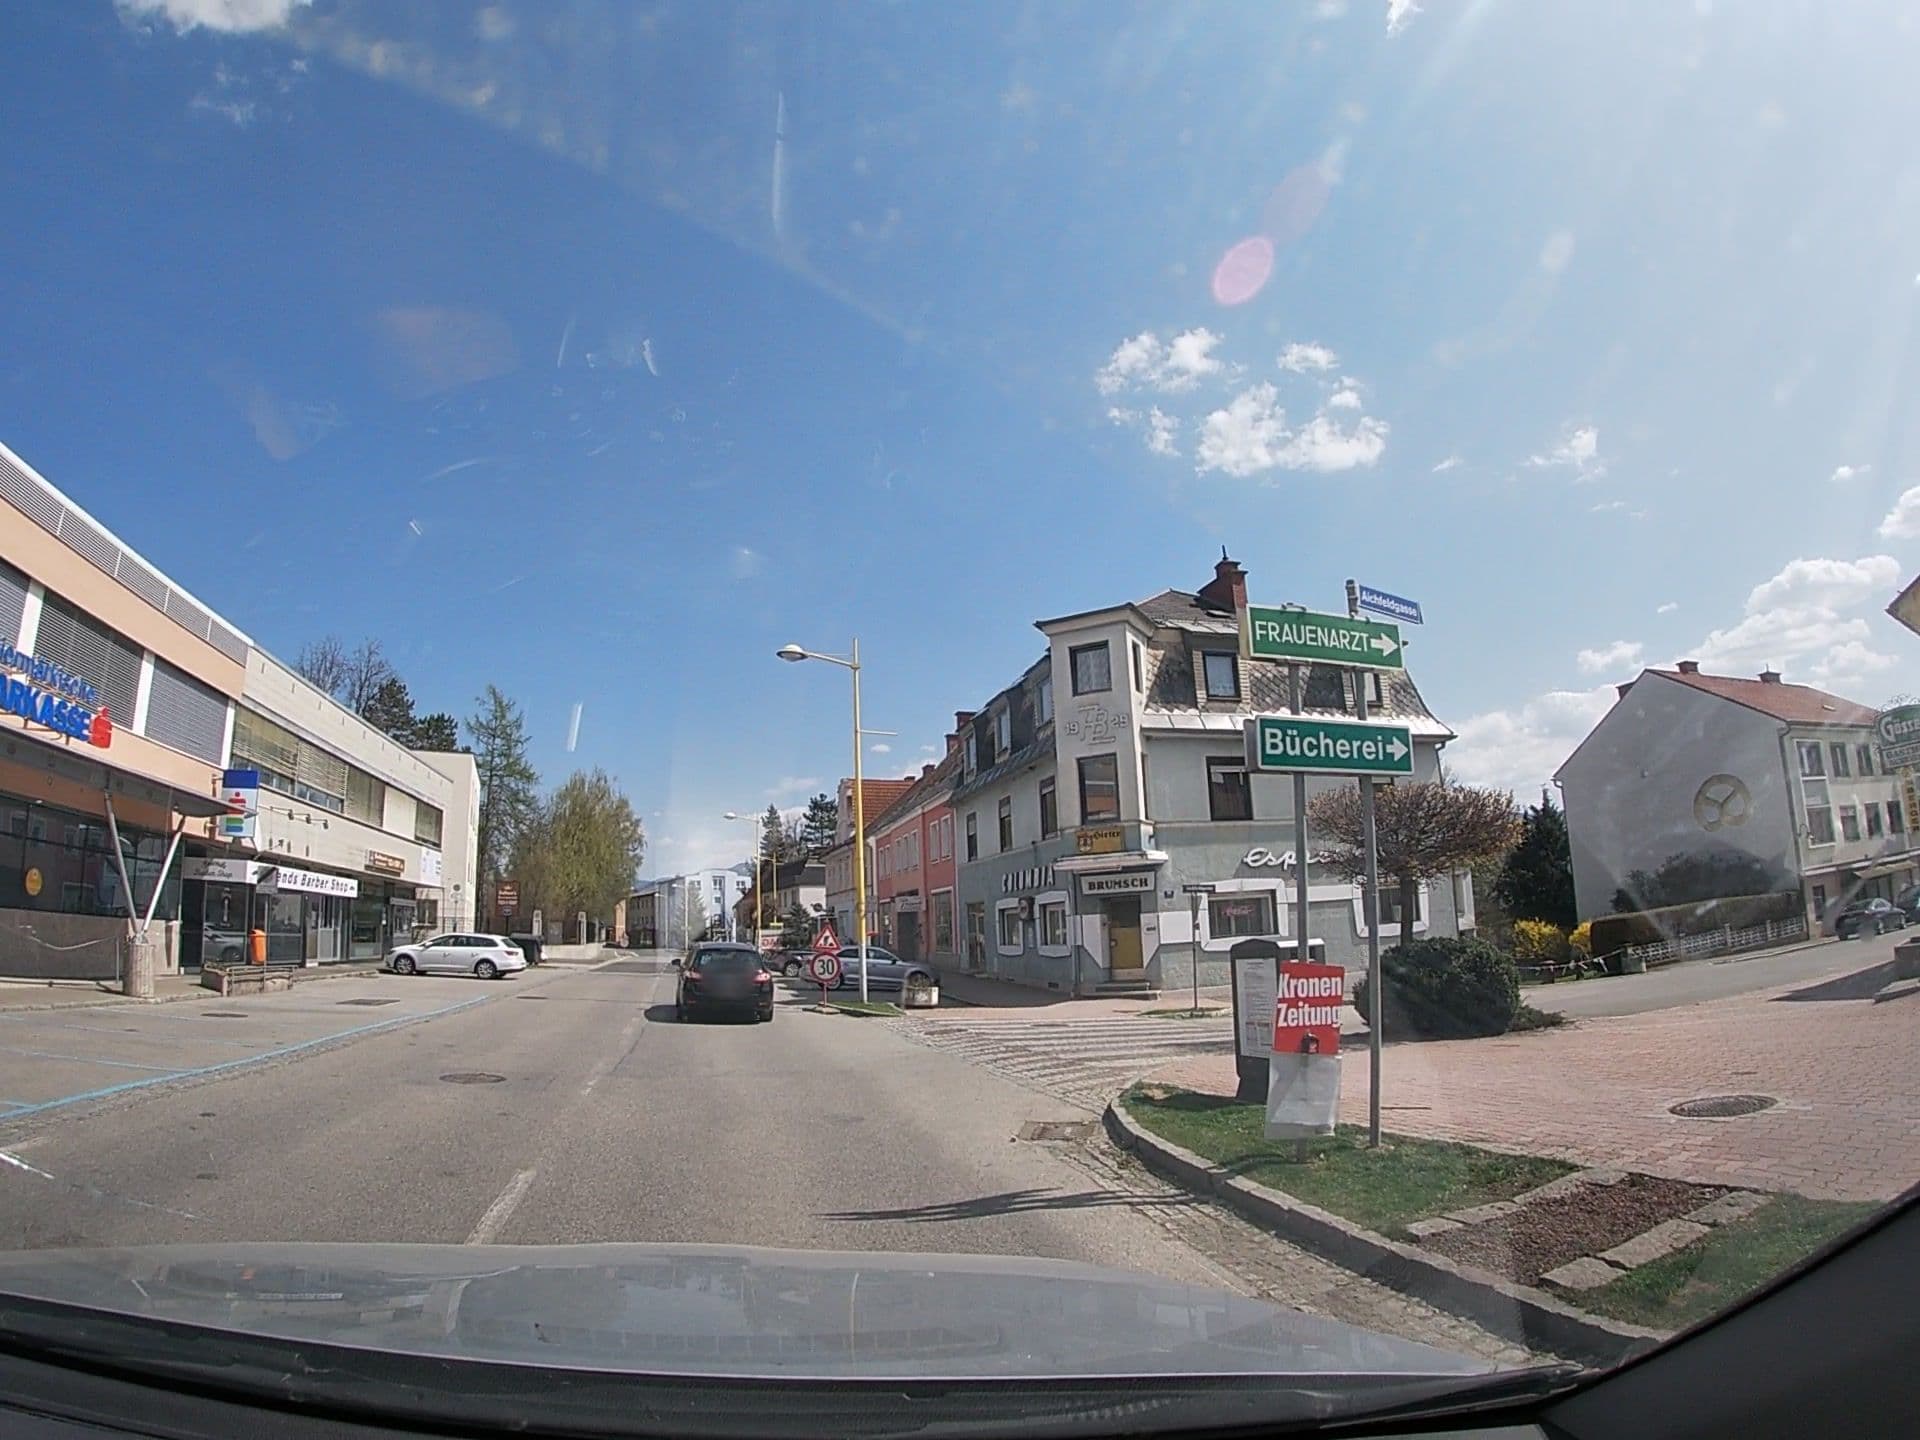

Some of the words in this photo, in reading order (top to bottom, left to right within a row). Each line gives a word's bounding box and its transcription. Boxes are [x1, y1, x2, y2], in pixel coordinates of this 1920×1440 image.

[1361, 590, 1417, 617] Aichfeldgasse
[1255, 620, 1370, 652] FRAUENARZT
[1264, 728, 1384, 760] Bücherei
[301, 874, 328, 889] Barber
[331, 879, 348, 893] Shop
[1088, 876, 1149, 891] BRUMSCH
[817, 958, 835, 975] 30
[1278, 973, 1342, 998] Kronen
[1278, 1001, 1342, 1028] Zeitung
